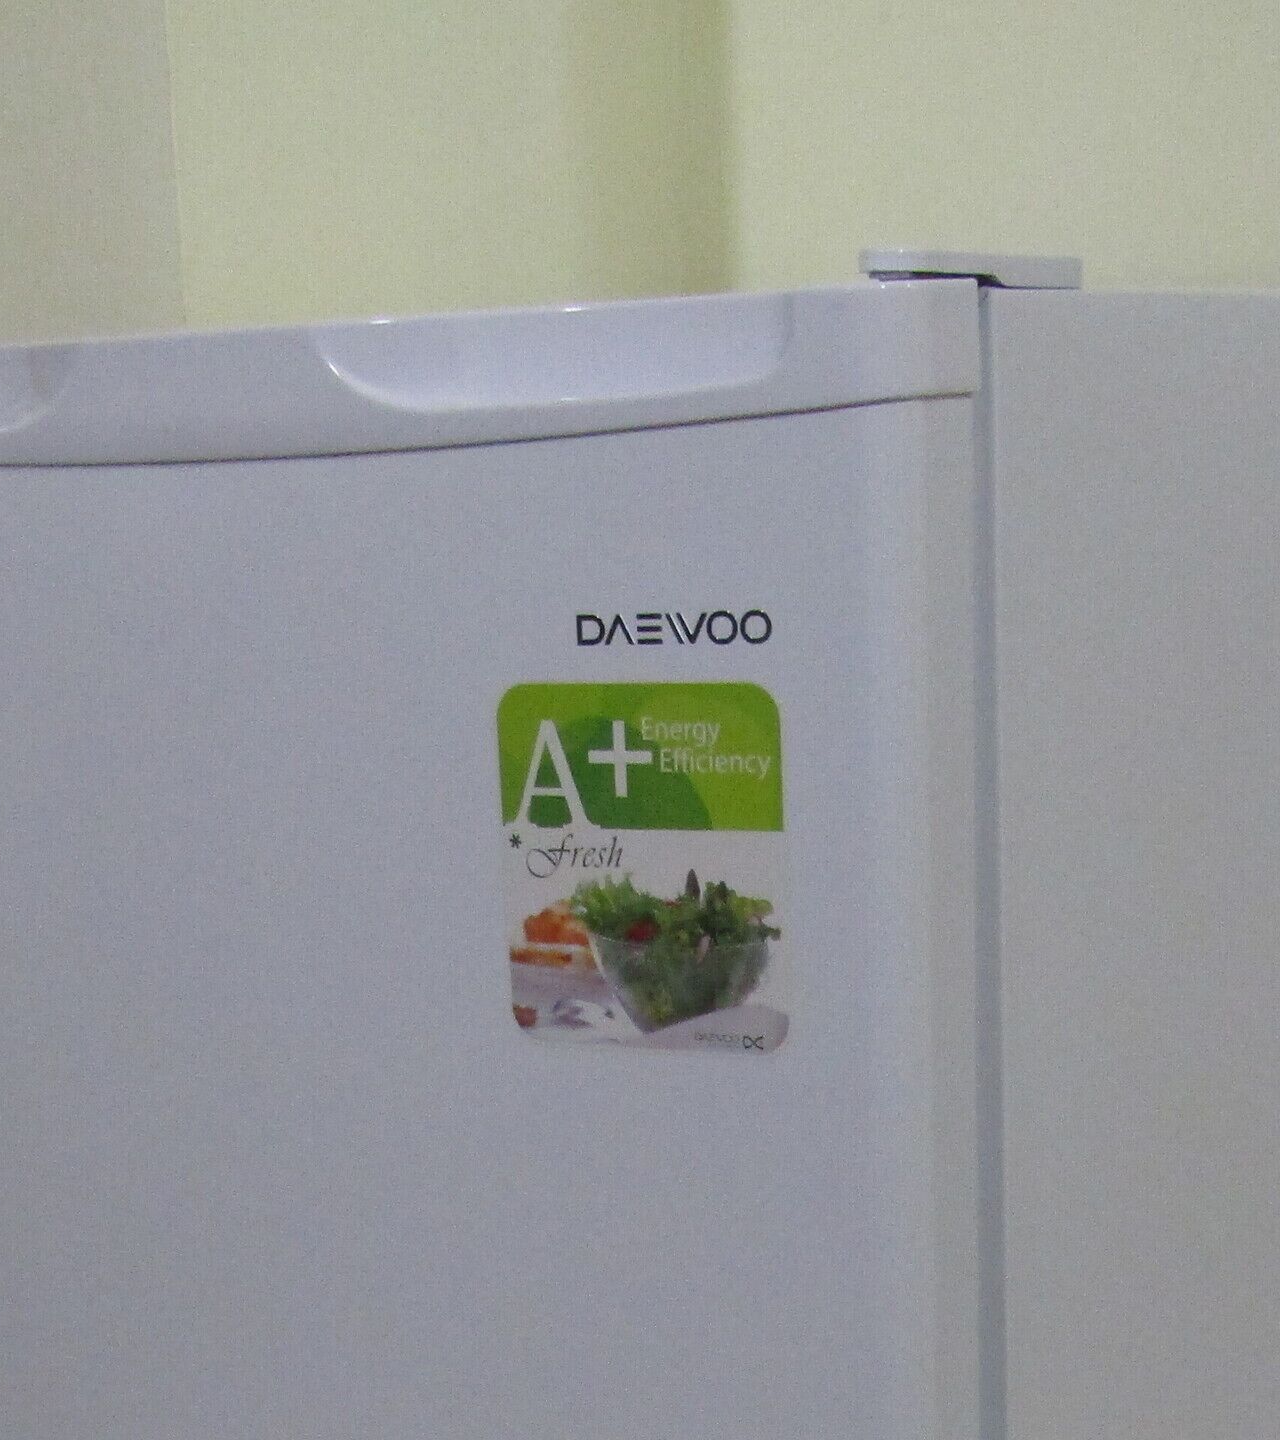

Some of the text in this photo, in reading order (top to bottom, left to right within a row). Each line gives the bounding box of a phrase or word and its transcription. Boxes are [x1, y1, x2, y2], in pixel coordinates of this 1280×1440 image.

[576, 609, 772, 645] DAEWOO
[641, 718, 720, 744] Energy
[515, 718, 653, 828] A+
[660, 748, 770, 779] Efficiency
